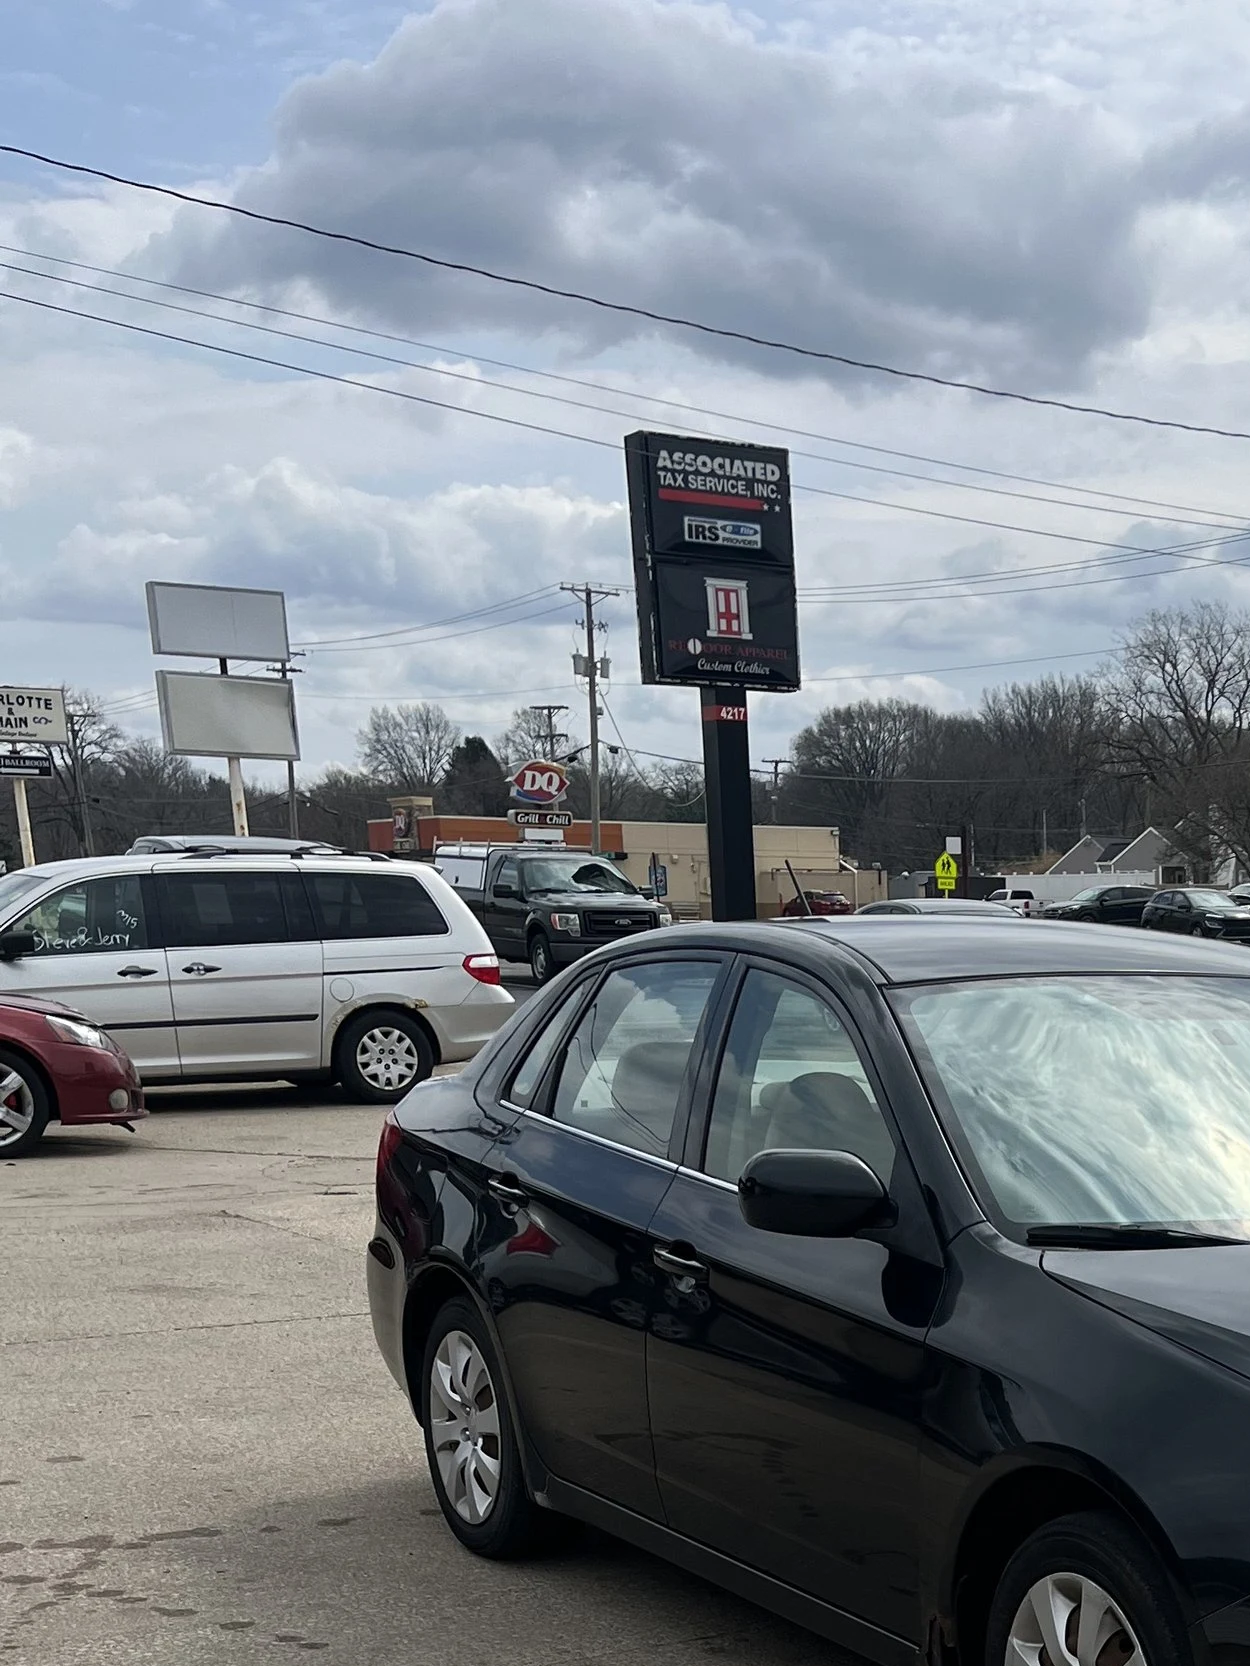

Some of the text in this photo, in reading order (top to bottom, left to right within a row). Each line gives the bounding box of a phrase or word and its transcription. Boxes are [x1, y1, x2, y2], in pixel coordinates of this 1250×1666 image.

[657, 450, 780, 481] ASSOCIATED
[657, 471, 781, 499] TAX SERVICE, INC.
[688, 523, 719, 541] IRS
[697, 658, 731, 673] Custom
[720, 706, 745, 720] 4217
[6, 758, 50, 767] BALLROOM
[523, 770, 562, 795] DQ
[517, 812, 539, 824] Grill
[546, 815, 569, 825] Chill
[94, 926, 129, 947] Jerry
